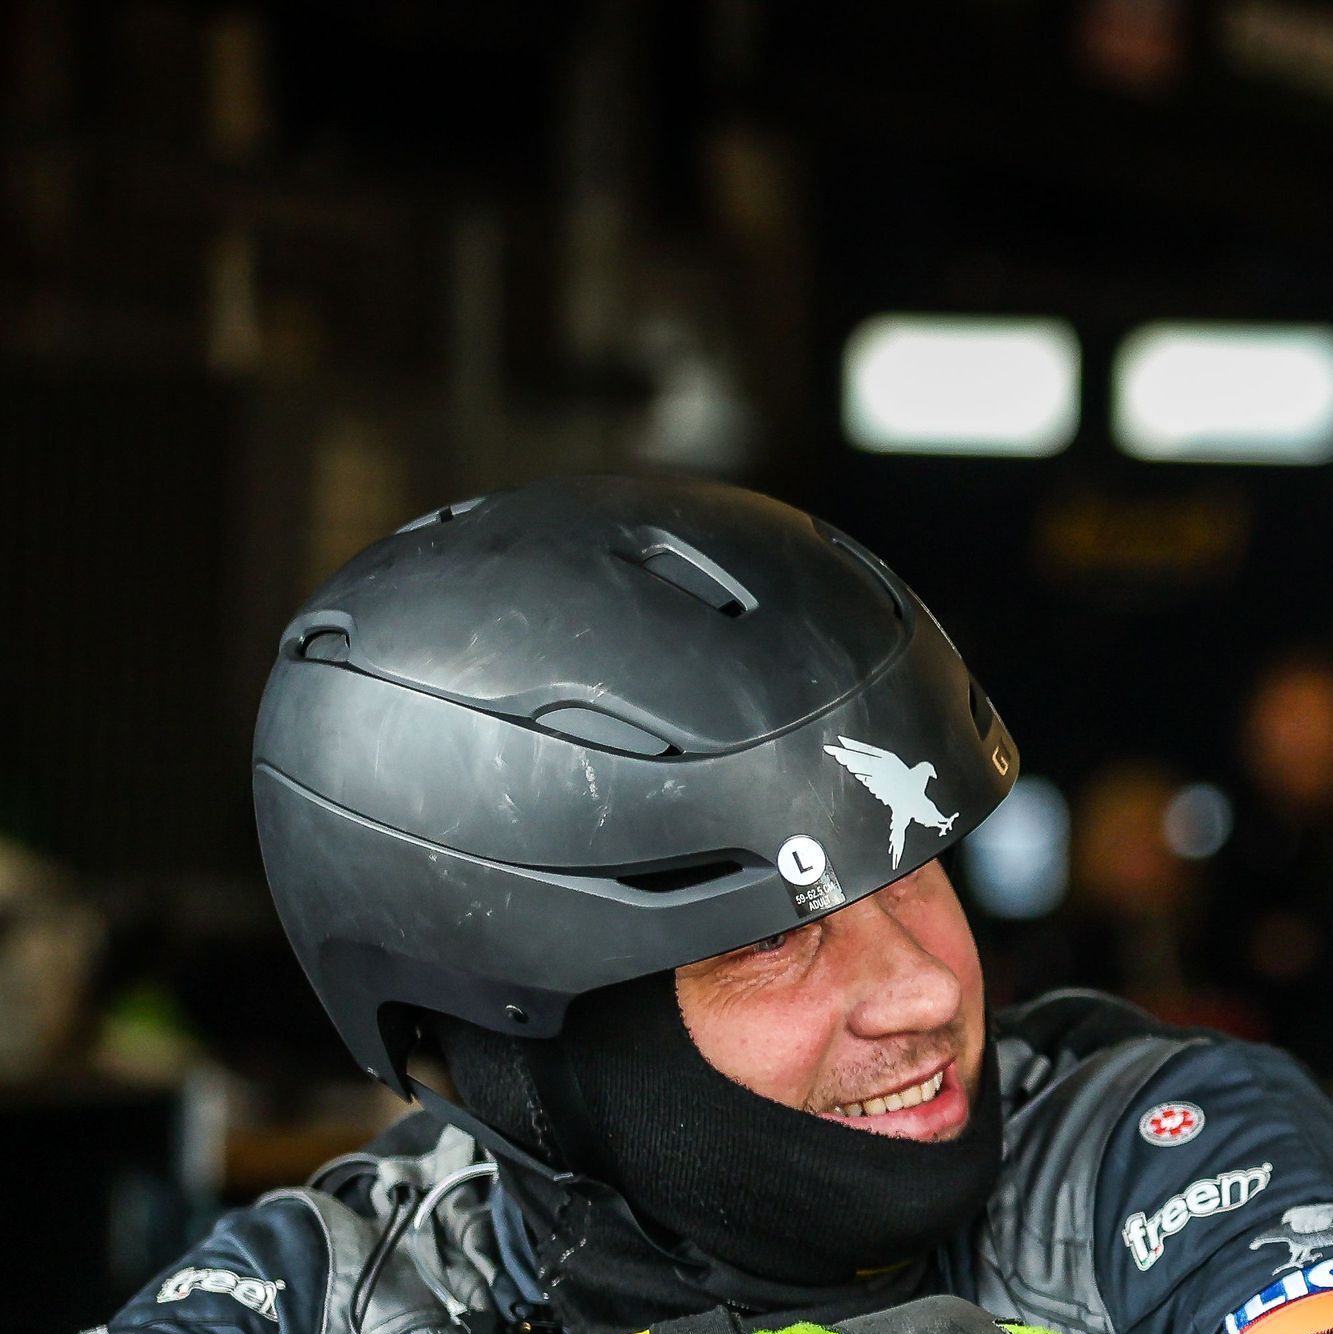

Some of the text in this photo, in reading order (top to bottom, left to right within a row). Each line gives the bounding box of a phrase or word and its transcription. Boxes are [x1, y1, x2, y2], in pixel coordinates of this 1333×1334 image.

[791, 850, 814, 875] L
[795, 884, 825, 905] 59-62.5
[808, 894, 832, 912] ADULT
[1124, 1167, 1272, 1269] freem
